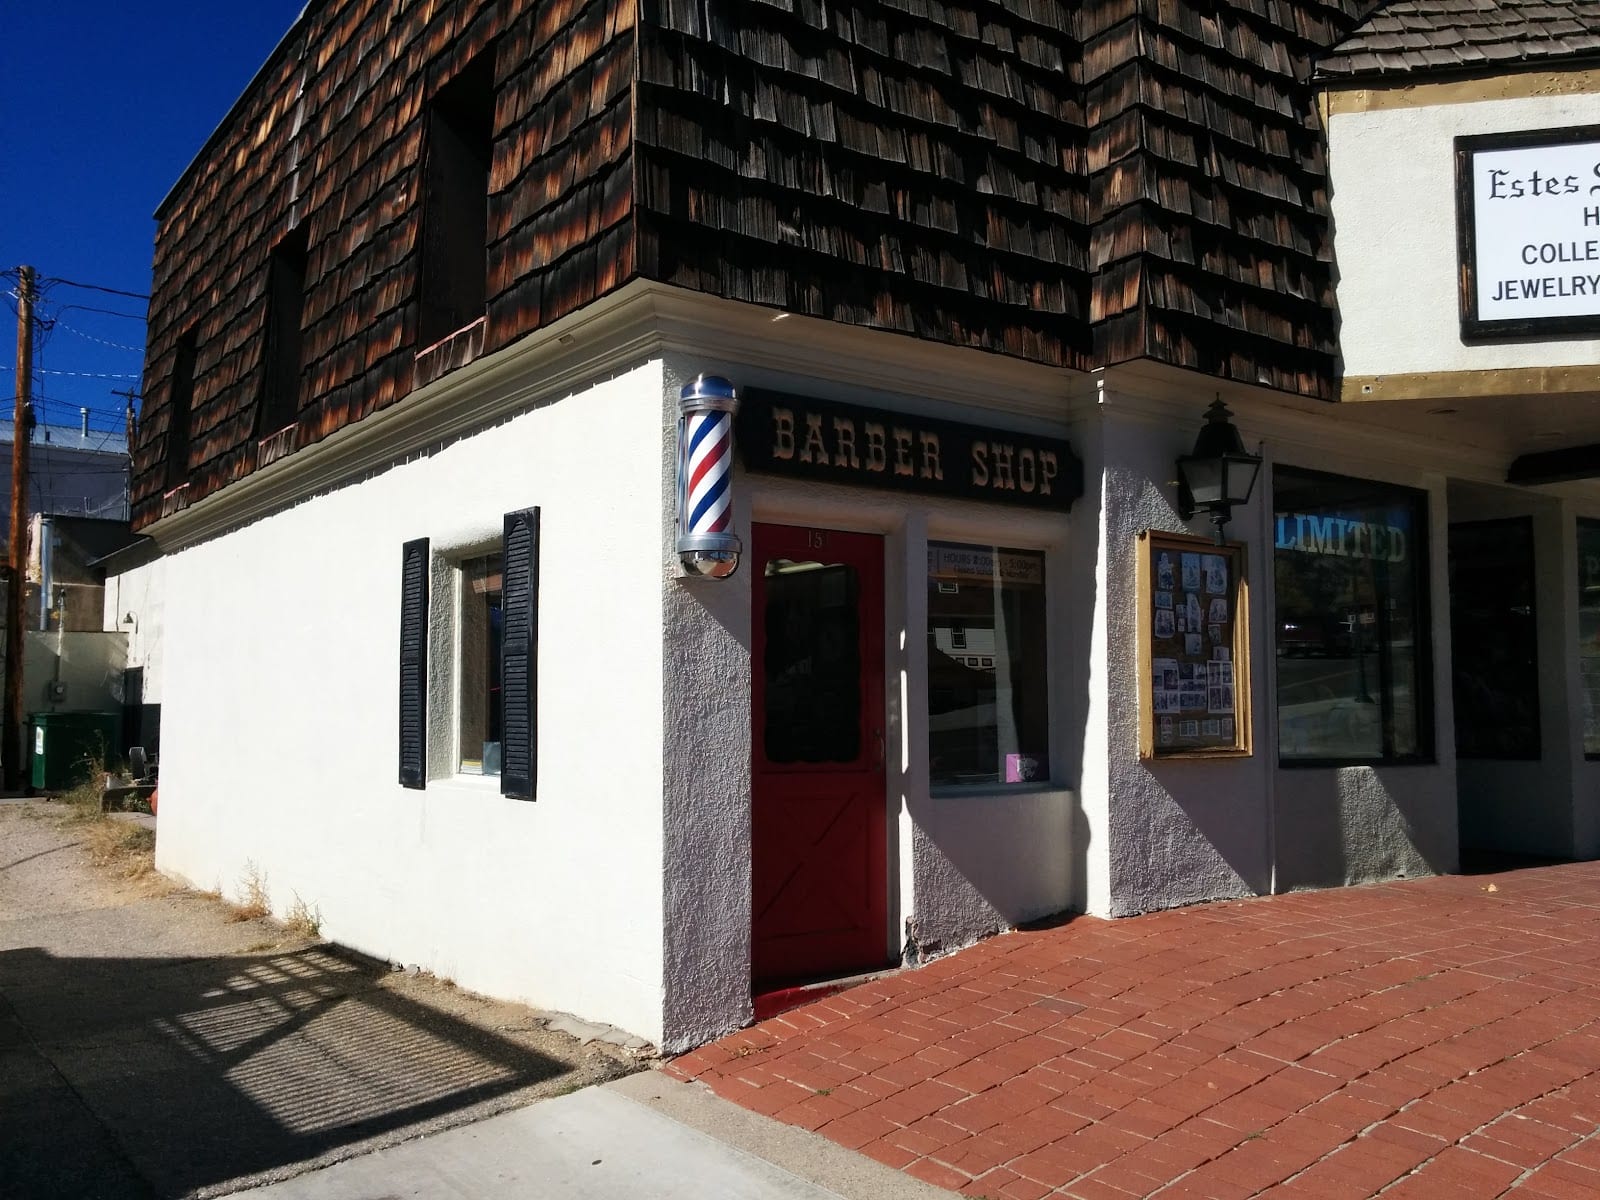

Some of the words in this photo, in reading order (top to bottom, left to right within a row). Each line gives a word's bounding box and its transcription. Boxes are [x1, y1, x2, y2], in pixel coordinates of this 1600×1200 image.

[1487, 168, 1580, 200] Estes
[771, 406, 944, 481] BARBER
[971, 440, 1059, 496] SHOP
[1275, 511, 1406, 563] LIMITED
